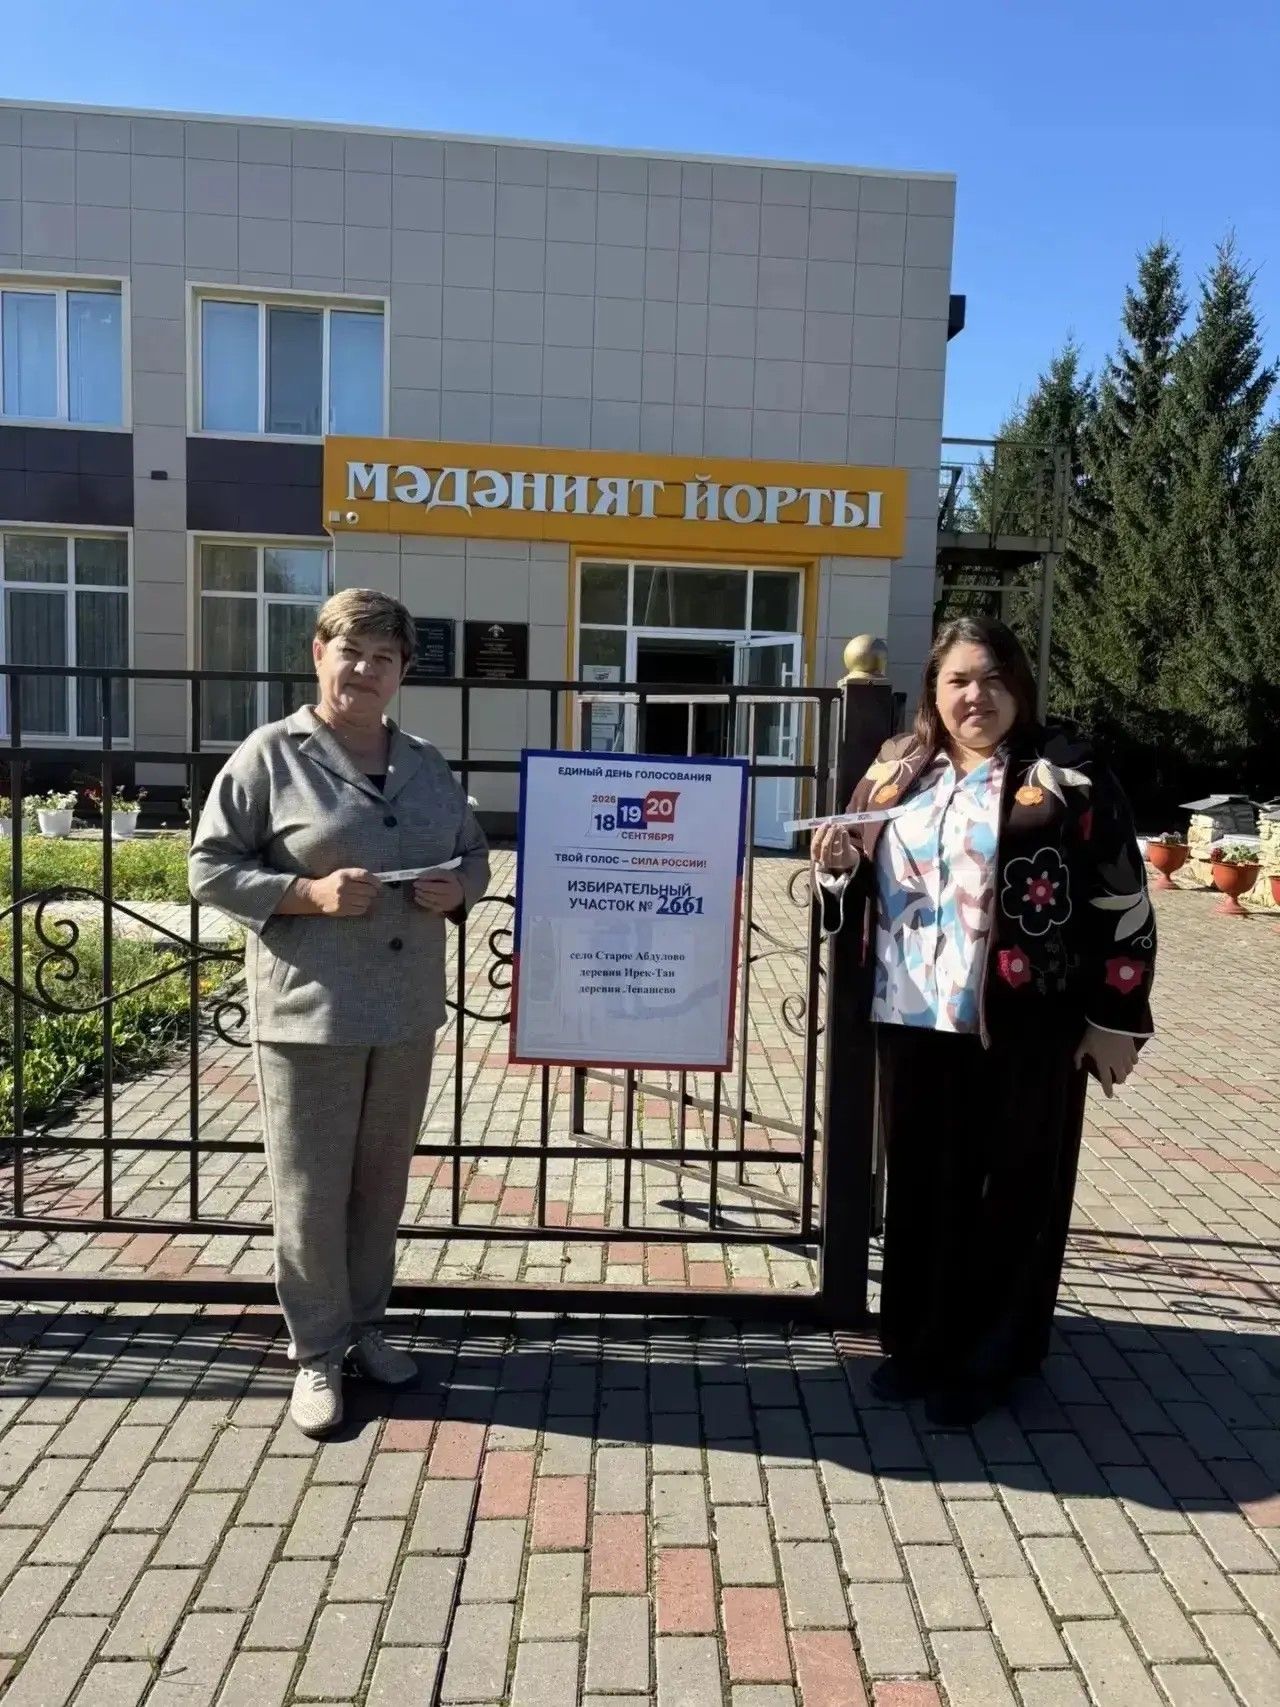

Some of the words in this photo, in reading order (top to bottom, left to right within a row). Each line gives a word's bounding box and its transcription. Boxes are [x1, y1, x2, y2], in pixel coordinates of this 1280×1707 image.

[345, 461, 666, 518] МӘДӘНИЯТ
[684, 473, 883, 530] ЙОРТЫ
[558, 766, 603, 777] ЕДИНЫЙ
[605, 769, 633, 779] ДЕНЬ
[635, 770, 712, 782] ГОЛОСОВАНИЯ
[592, 794, 617, 804] 2026
[594, 814, 616, 831] 18
[620, 805, 642, 823] 19
[646, 798, 673, 816] 20
[621, 831, 674, 842] СЕНТЯБРЯ
[555, 852, 583, 863] ТВОЙ
[585, 854, 619, 864] ГОЛОС
[631, 856, 660, 866] СИЛА
[661, 858, 707, 869] РОССИИ!
[568, 880, 691, 897] ИЗБИРАТЕЛЬНЫЙ
[569, 897, 635, 912] УЧАСТОК
[638, 901, 653, 912] №
[656, 896, 704, 915] 2661
[570, 951, 593, 960] село
[595, 951, 633, 963] Старое
[635, 951, 685, 963] Абдулово
[580, 968, 621, 978] деревня
[579, 985, 621, 995] деревня
